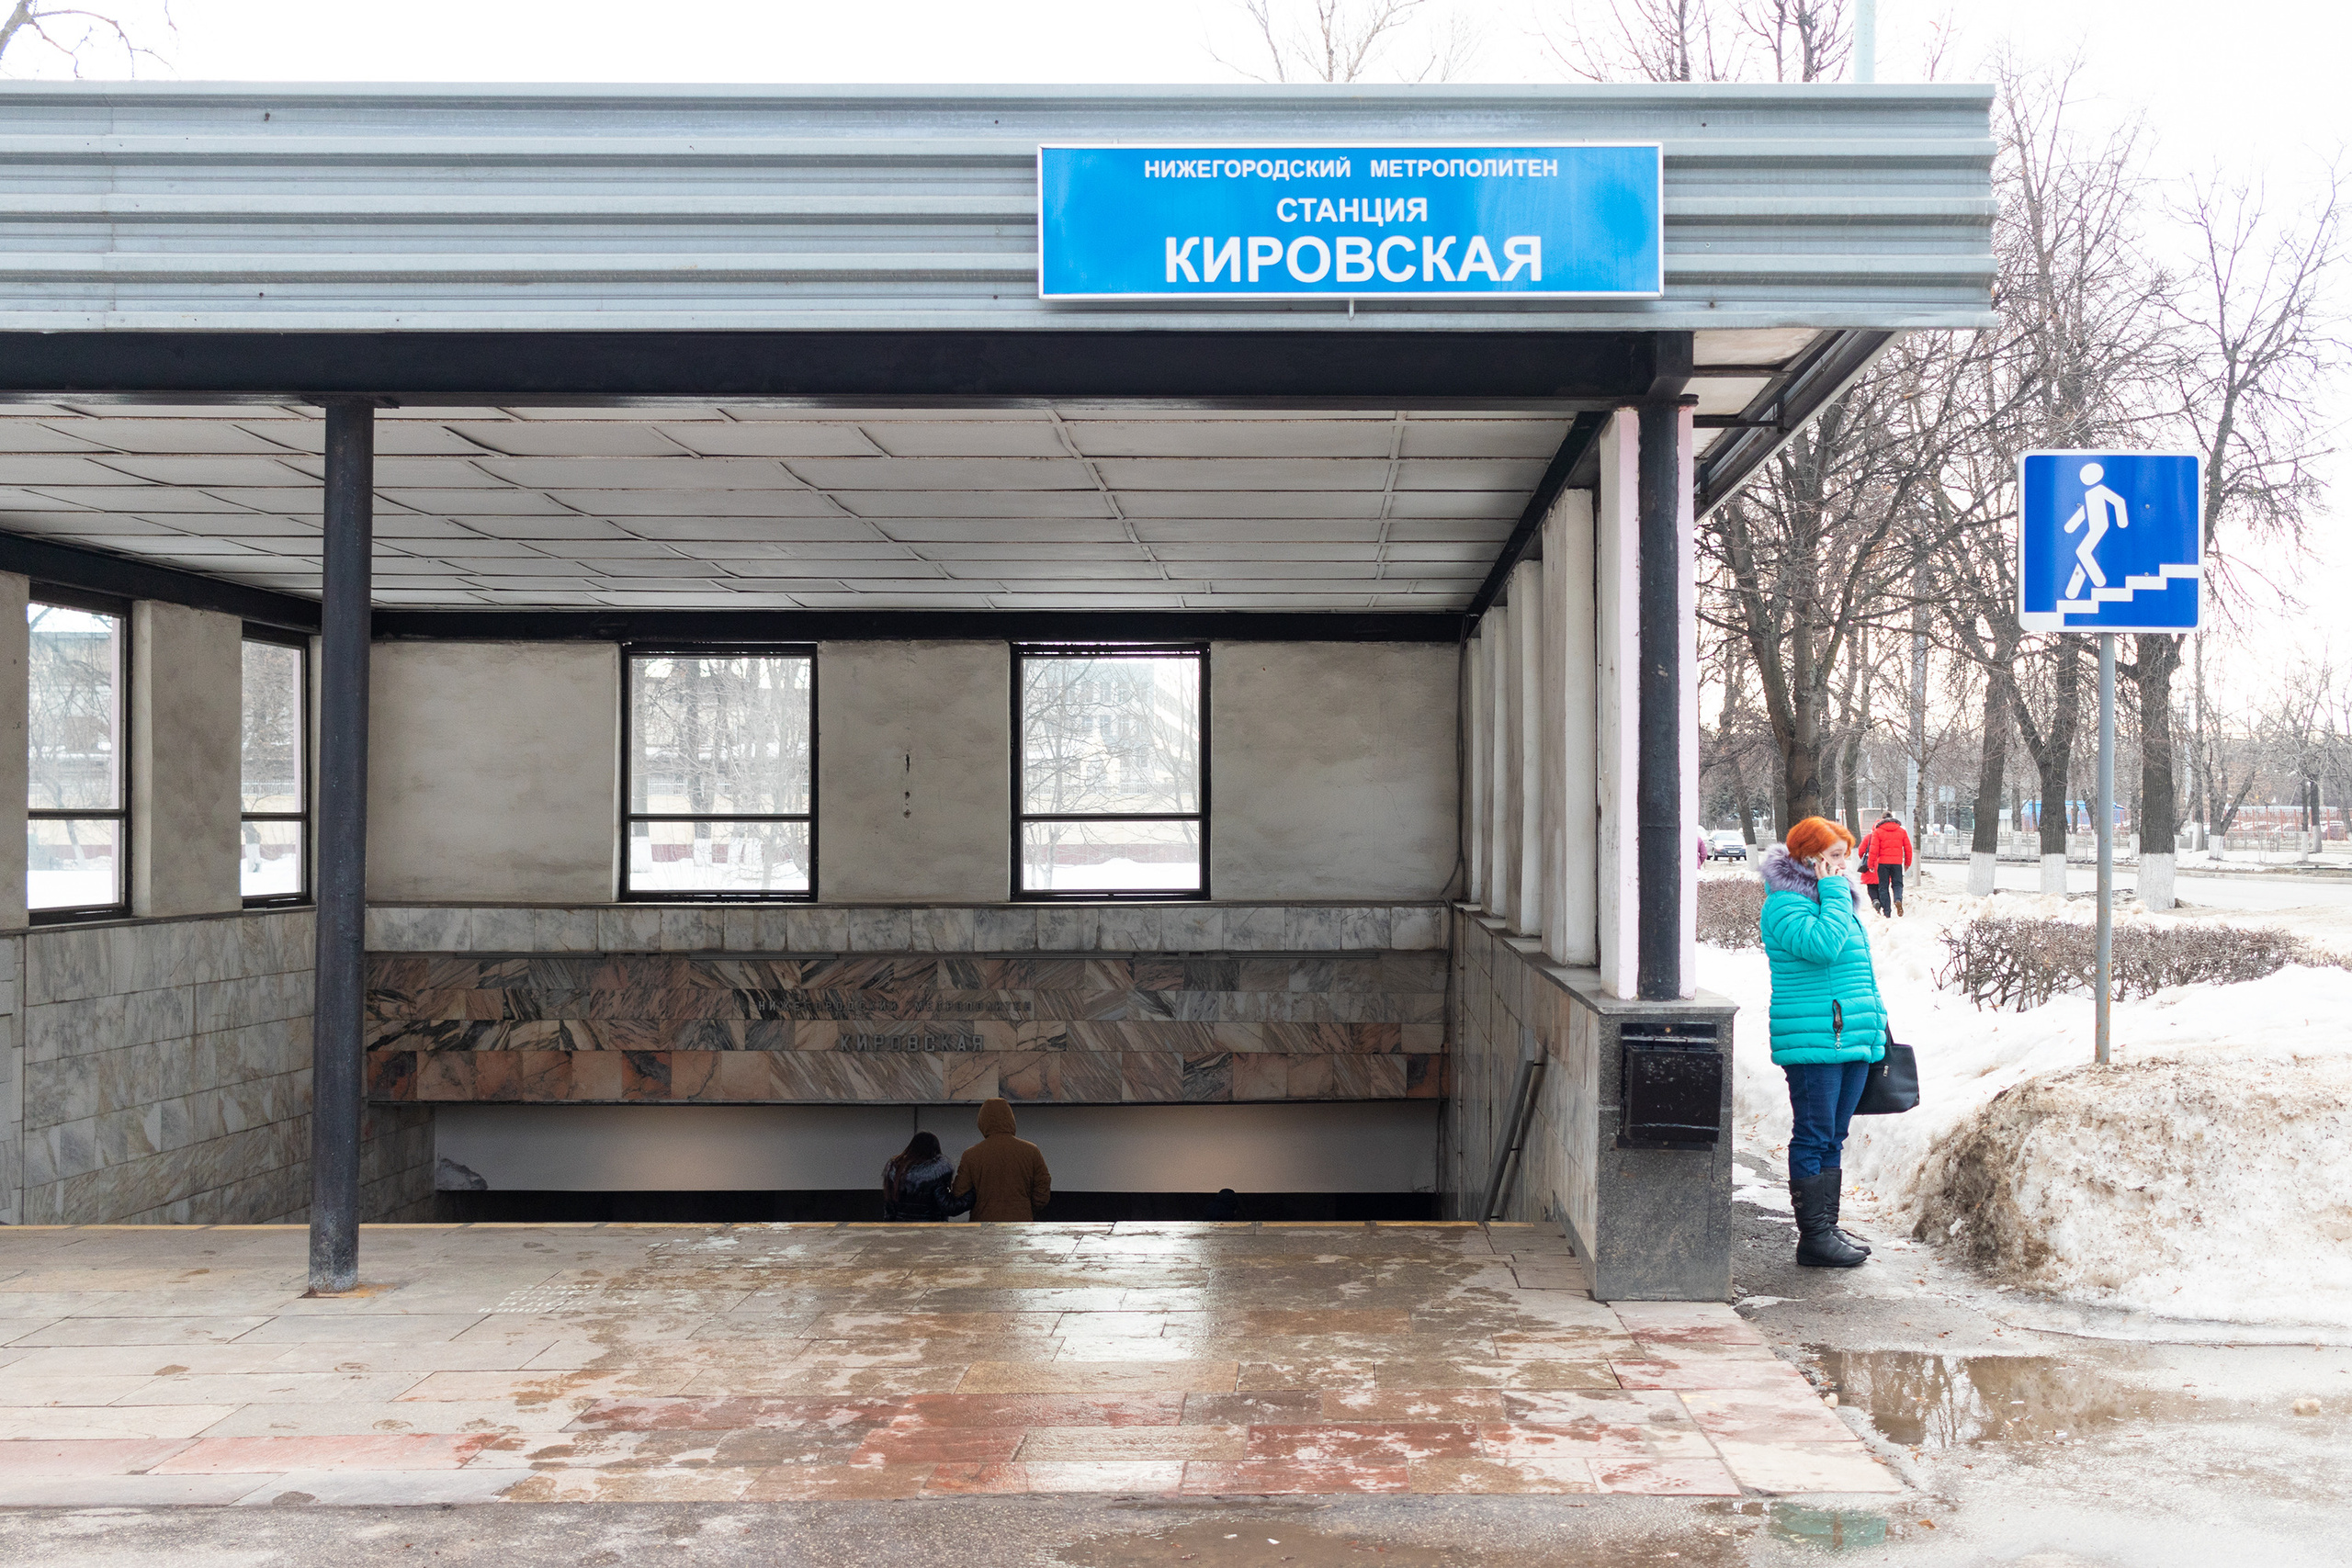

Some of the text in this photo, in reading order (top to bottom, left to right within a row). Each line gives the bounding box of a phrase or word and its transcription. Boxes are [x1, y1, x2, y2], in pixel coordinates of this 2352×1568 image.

[1145, 156, 1560, 181] НИЖЕГОРОДСКИЙ МЕТРОПОЛИТЕН
[1277, 197, 1428, 227] СТАНЦИЯ
[1165, 235, 1543, 283] КИРОВСКАЯ
[914, 999, 1032, 1011] МЕТРОПОЛИТЕН
[840, 1033, 985, 1053] КИРОВСКАЯ
